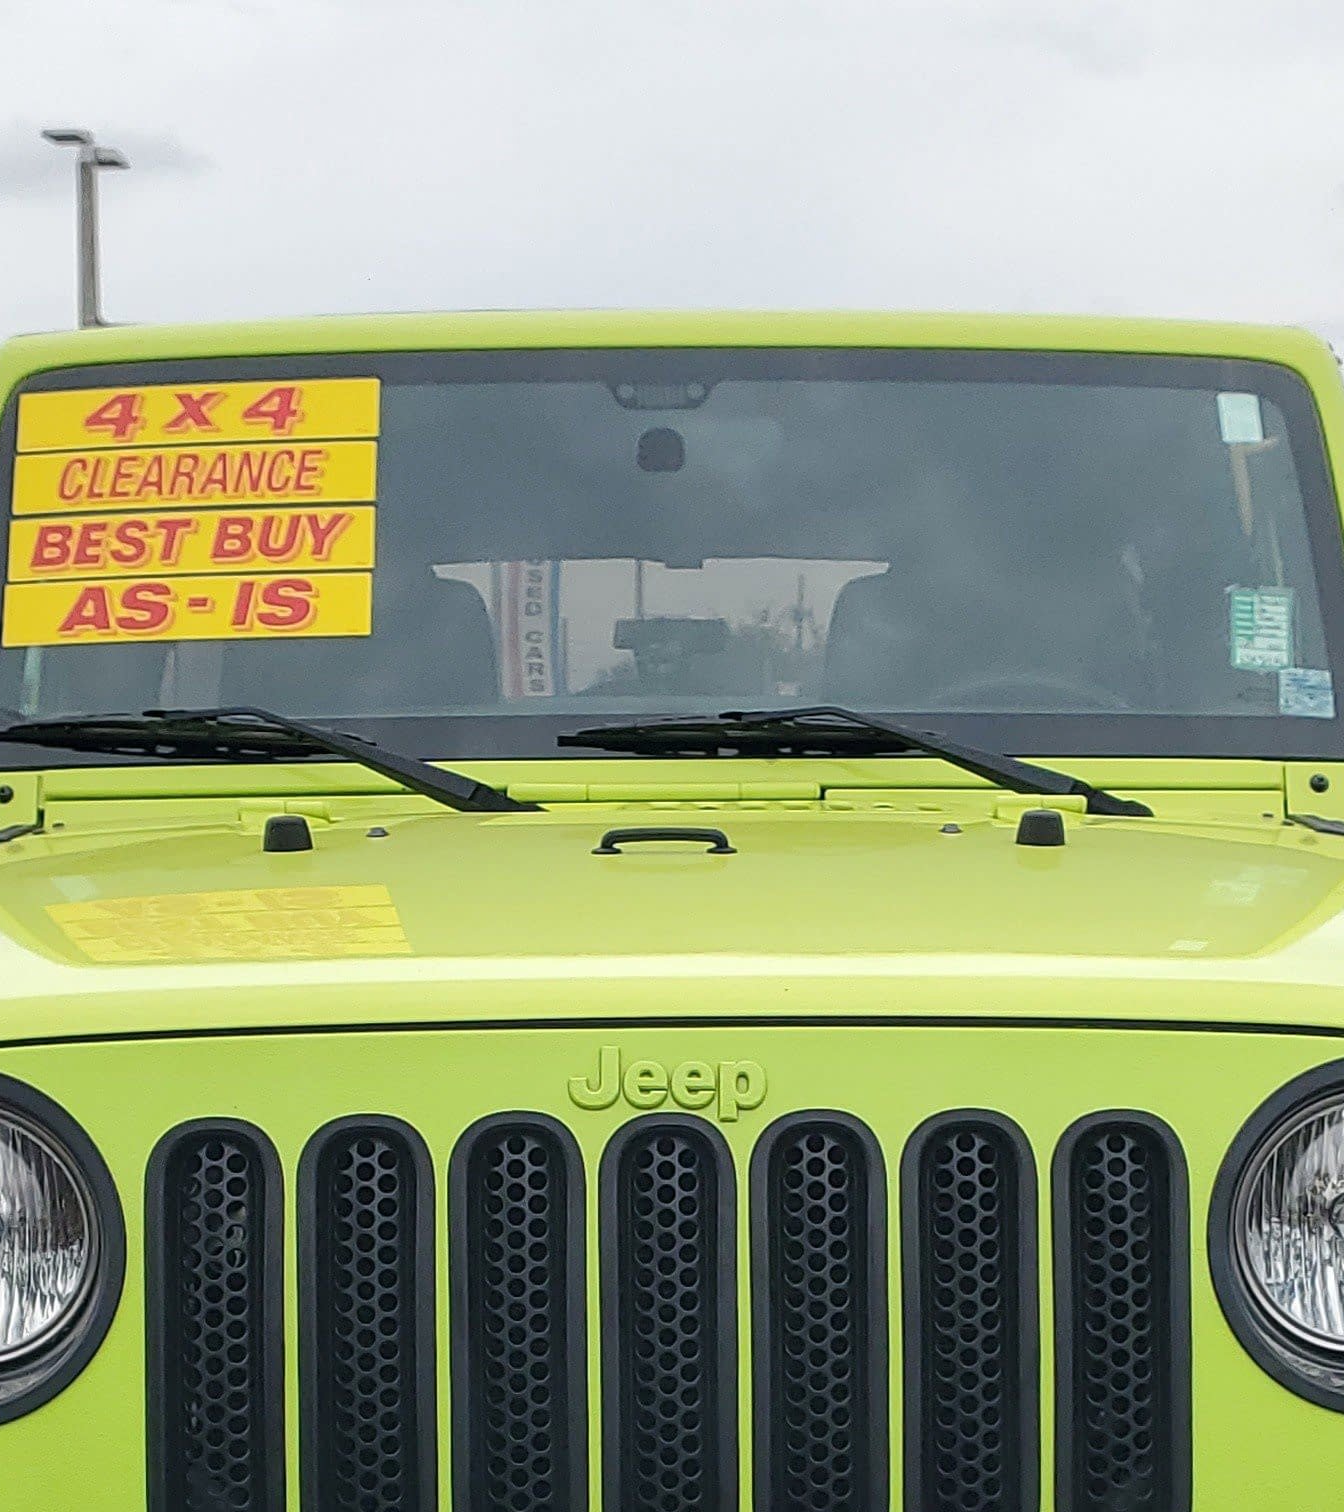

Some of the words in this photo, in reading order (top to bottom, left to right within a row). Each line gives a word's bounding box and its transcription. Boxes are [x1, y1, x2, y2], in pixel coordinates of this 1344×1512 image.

[58, 448, 328, 503] CLEARANCE
[29, 518, 198, 573] BEST
[210, 511, 355, 564] BUY
[524, 631, 545, 692] CARS
[567, 1045, 768, 1122] Jeep
